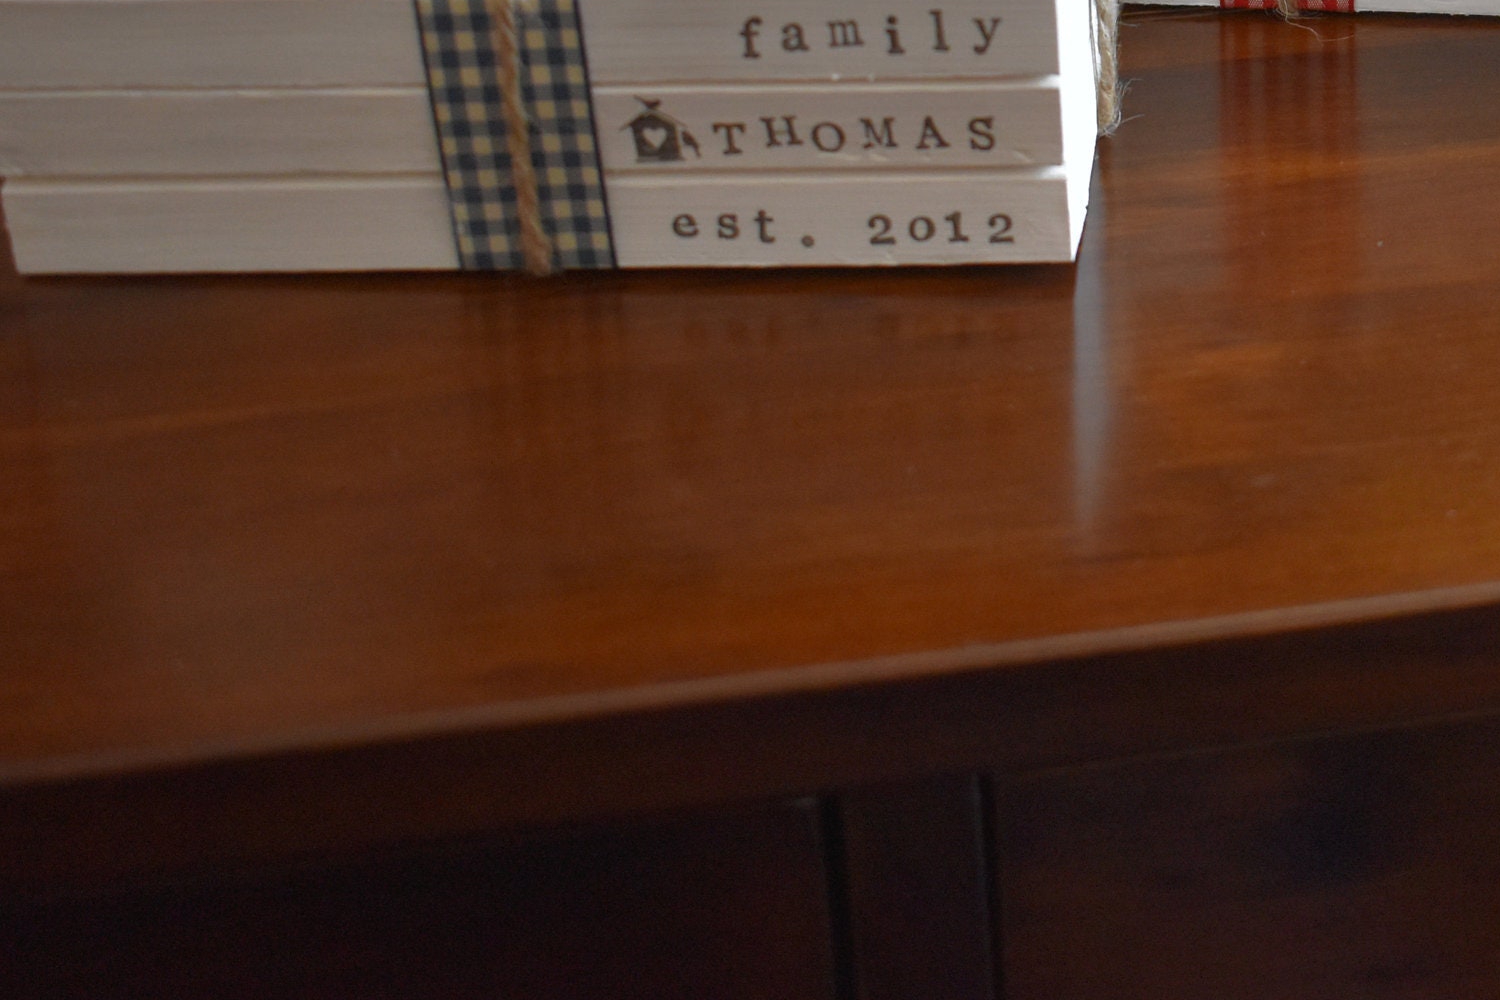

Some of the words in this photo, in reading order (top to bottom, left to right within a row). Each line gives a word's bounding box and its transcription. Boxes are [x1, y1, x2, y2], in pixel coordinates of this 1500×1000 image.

[739, 9, 1002, 59] family
[712, 115, 997, 155] THOMAS
[671, 209, 815, 248] est.
[867, 211, 1015, 246] 2012
